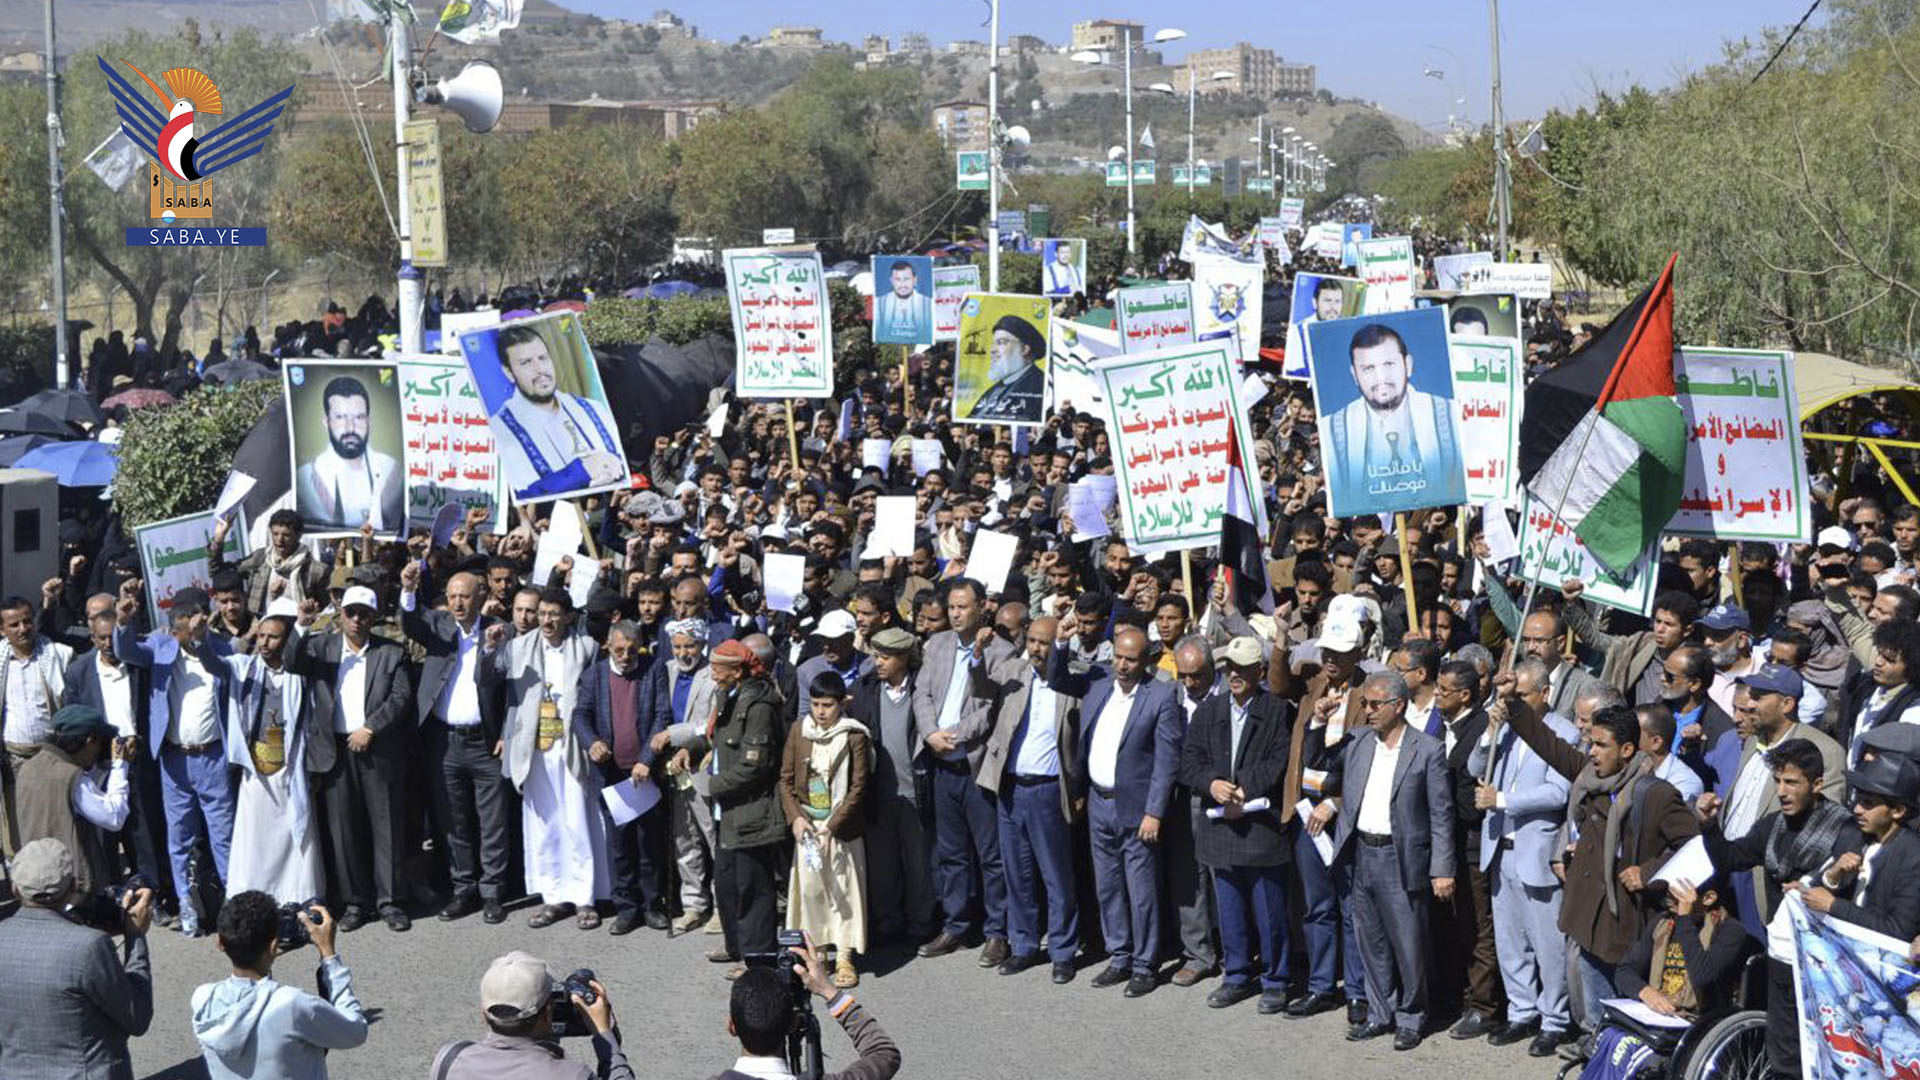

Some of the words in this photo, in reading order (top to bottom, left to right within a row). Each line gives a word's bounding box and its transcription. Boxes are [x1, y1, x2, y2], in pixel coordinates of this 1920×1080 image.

[403, 368, 456, 403] أكبر
[1118, 363, 1176, 410] أكبر
[1184, 361, 1225, 392] الله
[1120, 405, 1179, 436] لأمريكا
[1182, 399, 1232, 427] الموت
[1461, 399, 1506, 422] البضائع
[1725, 414, 1785, 446] البضائع
[453, 437, 496, 458] الموت
[1717, 453, 1726, 477] و
[1132, 472, 1174, 500] اليهود
[1178, 470, 1201, 495] على
[1138, 499, 1194, 539] للإسلام
